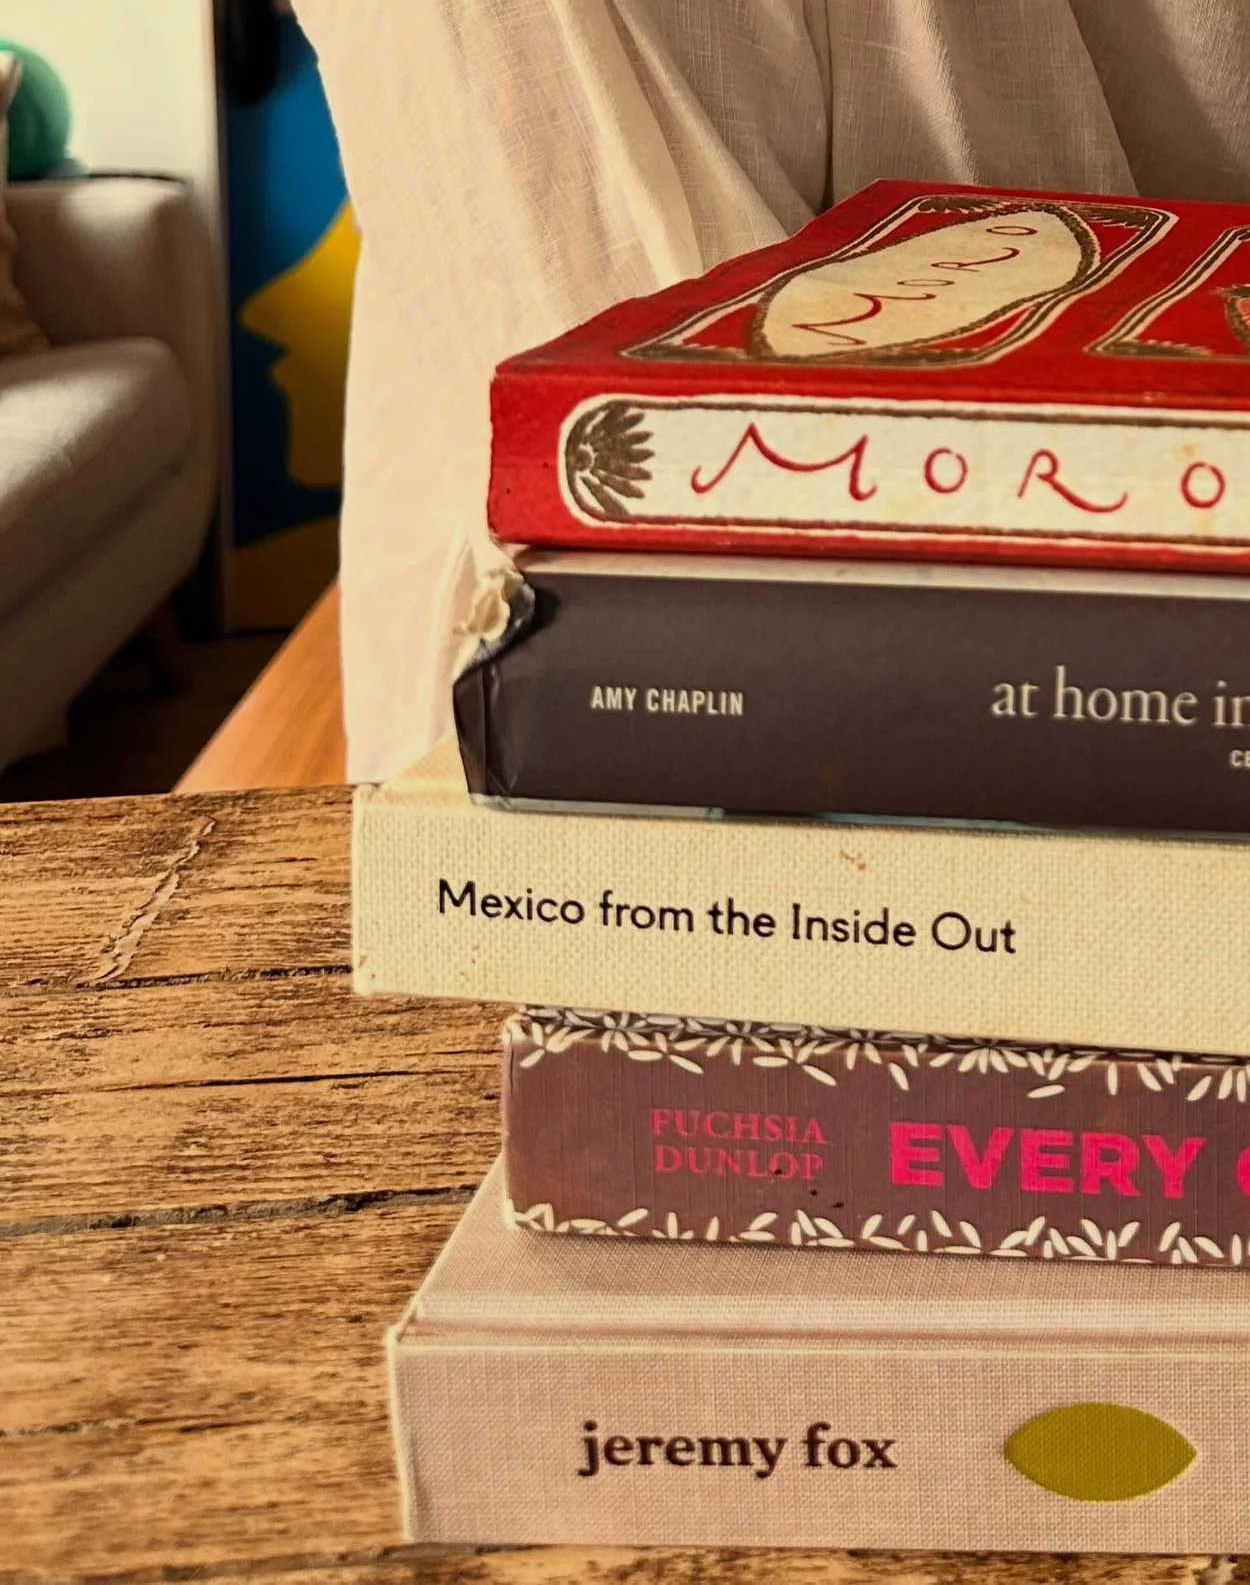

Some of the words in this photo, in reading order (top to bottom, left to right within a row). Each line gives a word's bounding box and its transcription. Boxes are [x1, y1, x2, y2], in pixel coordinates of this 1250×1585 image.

[792, 225, 1038, 346] MORO
[690, 420, 1226, 514] MORO
[590, 685, 637, 711] AMY
[644, 687, 745, 716] CHAPLIN
[990, 681, 1041, 717] at
[1053, 665, 1199, 726] home
[437, 878, 585, 925] Mexico
[599, 889, 696, 933] from
[707, 897, 777, 937] the
[792, 903, 917, 947] Inside
[931, 911, 1016, 954] Out
[650, 1108, 829, 1145] FUCHSIA
[653, 1144, 825, 1181] DUNLOP
[888, 1121, 1206, 1200] EVERY
[577, 1419, 789, 1479] jeremy
[802, 1421, 898, 1470] fox
